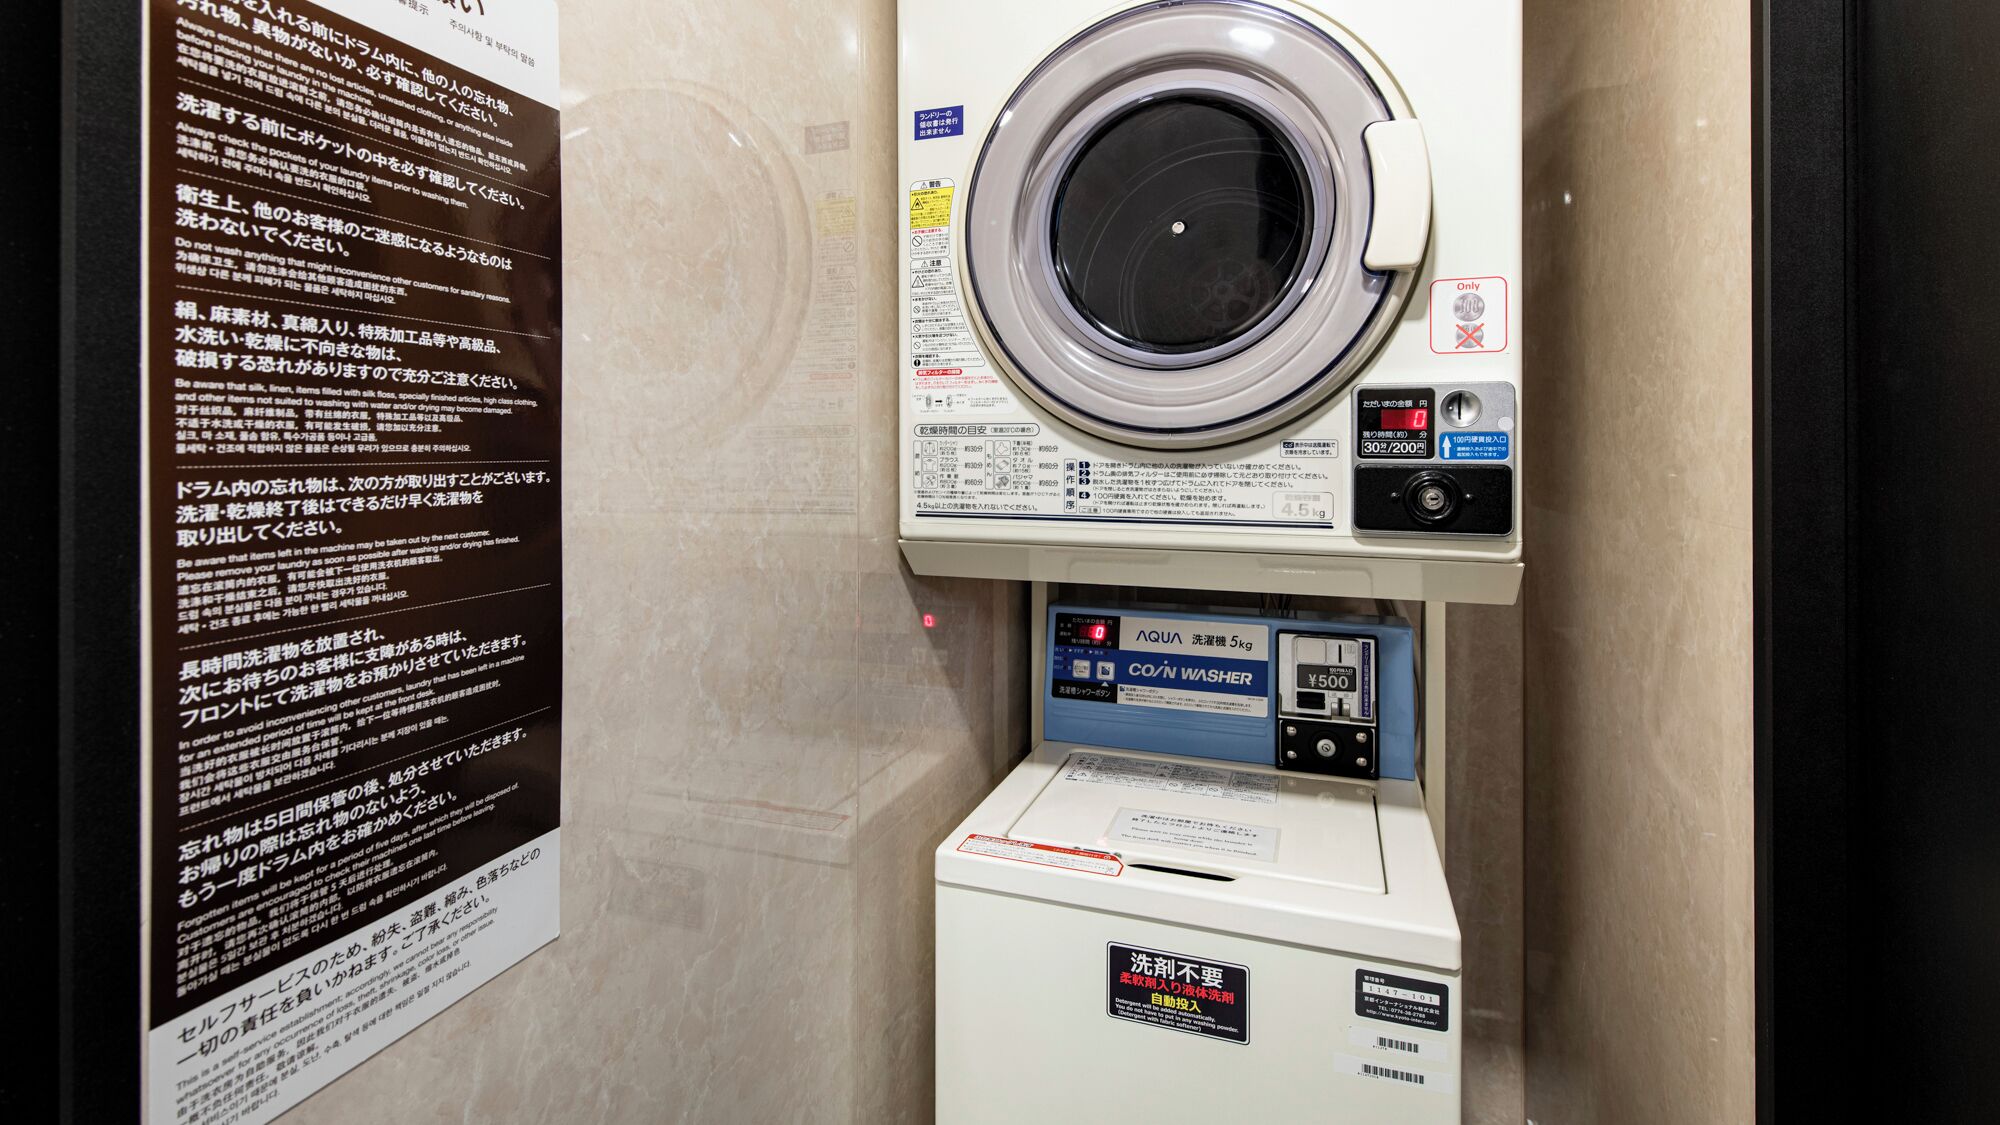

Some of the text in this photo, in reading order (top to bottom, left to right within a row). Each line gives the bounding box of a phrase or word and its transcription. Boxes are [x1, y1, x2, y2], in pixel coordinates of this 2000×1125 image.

[231, 0, 512, 115] を入れる前にドラム内に、他の人の忘れ物、
[450, 18, 534, 67] 주의사항 및 부탁의 말씀
[176, 16, 215, 37] Always
[217, 33, 252, 50] ensure
[253, 45, 272, 58] that
[274, 53, 298, 67] there
[300, 63, 314, 73] are
[316, 69, 328, 78] no
[329, 72, 344, 84] lost
[346, 80, 376, 97] articles,
[378, 93, 415, 111] unwashed
[416, 107, 445, 123] clothing,
[454, 121, 481, 137] anything
[482, 132, 494, 140] else
[495, 136, 513, 147] inside
[920, 110, 952, 120] ランドリーの
[920, 128, 951, 136] 出来ません
[175, 121, 215, 138] Always
[218, 134, 248, 147] check
[251, 142, 267, 152] the
[269, 148, 306, 163] pockets
[319, 162, 338, 171] your
[340, 166, 370, 182] laundry
[371, 175, 392, 187] items
[393, 182, 411, 192] prior
[421, 190, 449, 204] washing
[450, 198, 468, 208] them.
[177, 93, 523, 209] 洗濯する前にポケットの中を必ず確認してください。
[176, 184, 511, 269] 衛生上、他のお客様のご迷惑になるようなものは
[176, 208, 349, 256] 洗わないでください。
[175, 236, 192, 248] Do
[194, 242, 212, 251] not
[214, 246, 242, 256] wash
[243, 250, 285, 265] anything
[287, 257, 305, 267] that
[307, 262, 332, 272] might
[334, 266, 390, 282] inconvenience
[392, 276, 412, 285] other
[412, 280, 449, 292] customers
[460, 289, 485, 299] sanitary
[486, 294, 510, 303] reasons.
[1457, 282, 1480, 291] Only
[175, 301, 499, 353] 絹、麻素材、真綿入り、特殊加工品等や高級品、
[175, 325, 400, 361] 水洗い・乾燥に不向きな物は、
[175, 349, 516, 389] 破損する恐れがありますので充分ご注意ください。
[920, 426, 986, 435] 乾燥時間の目安
[1414, 410, 1426, 427] 0
[178, 471, 549, 498] ドラム内の忘れ物は、次の方が取り出すことがございます。
[1066, 462, 1076, 510] 操作順序
[176, 490, 482, 522] 洗濯・乾燥終了後はできるだけ早く洗濯物を
[1281, 503, 1309, 516] 4.5
[176, 520, 341, 547] 取り出してください。
[1095, 627, 1104, 638] 0
[1136, 630, 1253, 651] AQUA 洗濯機 5kg
[179, 628, 384, 680] 長時間洗濯物を放置され、
[180, 630, 466, 704] 次にお待ちのお客様に支障がある時は、
[181, 634, 525, 727] フロントにて洗濯物をお預かりさせていただきます。
[1129, 660, 1252, 686] COIN WASHER
[1308, 673, 1349, 689] ¥500
[1059, 686, 1110, 697] 洗濯槽シャワーボタン
[179, 728, 525, 860] 忘れ物は5日間保管の後、処分させていただきます。
[179, 784, 425, 883] お帰りの際は忘れ物のないよう、
[179, 792, 456, 907] もう一度ドラム内をお確かめください。
[176, 915, 235, 944] Customers
[238, 907, 254, 918] are
[256, 881, 311, 910] encouraged
[324, 866, 349, 882] check
[352, 858, 369, 870] their
[372, 842, 407, 861] machines
[408, 836, 422, 846] one
[423, 829, 435, 839] last
[436, 823, 451, 833] time
[452, 813, 472, 826] before
[473, 803, 494, 816] leaving.
[179, 848, 540, 1042] セルフサービスのため、紛失、盗難、縮み、色落ちなどの
[178, 895, 487, 1063] 一切の責任を負いかねます。ご了承ください。
[1131, 952, 1223, 988] 洗剤不要
[1120, 972, 1234, 1005] 柔軟剤入り液体洗剤
[1152, 992, 1201, 1013] 自動投入
[1116, 998, 1141, 1007] Detergent
[1161, 1006, 1177, 1014] added
[1178, 1009, 1215, 1022] automatically.
[1118, 1010, 1146, 1020] (Detergent
[1160, 1017, 1176, 1026] fabric
[1176, 1020, 1201, 1032] softener)
[1193, 1018, 1215, 1029] washing
[1217, 1024, 1239, 1034] powder.
